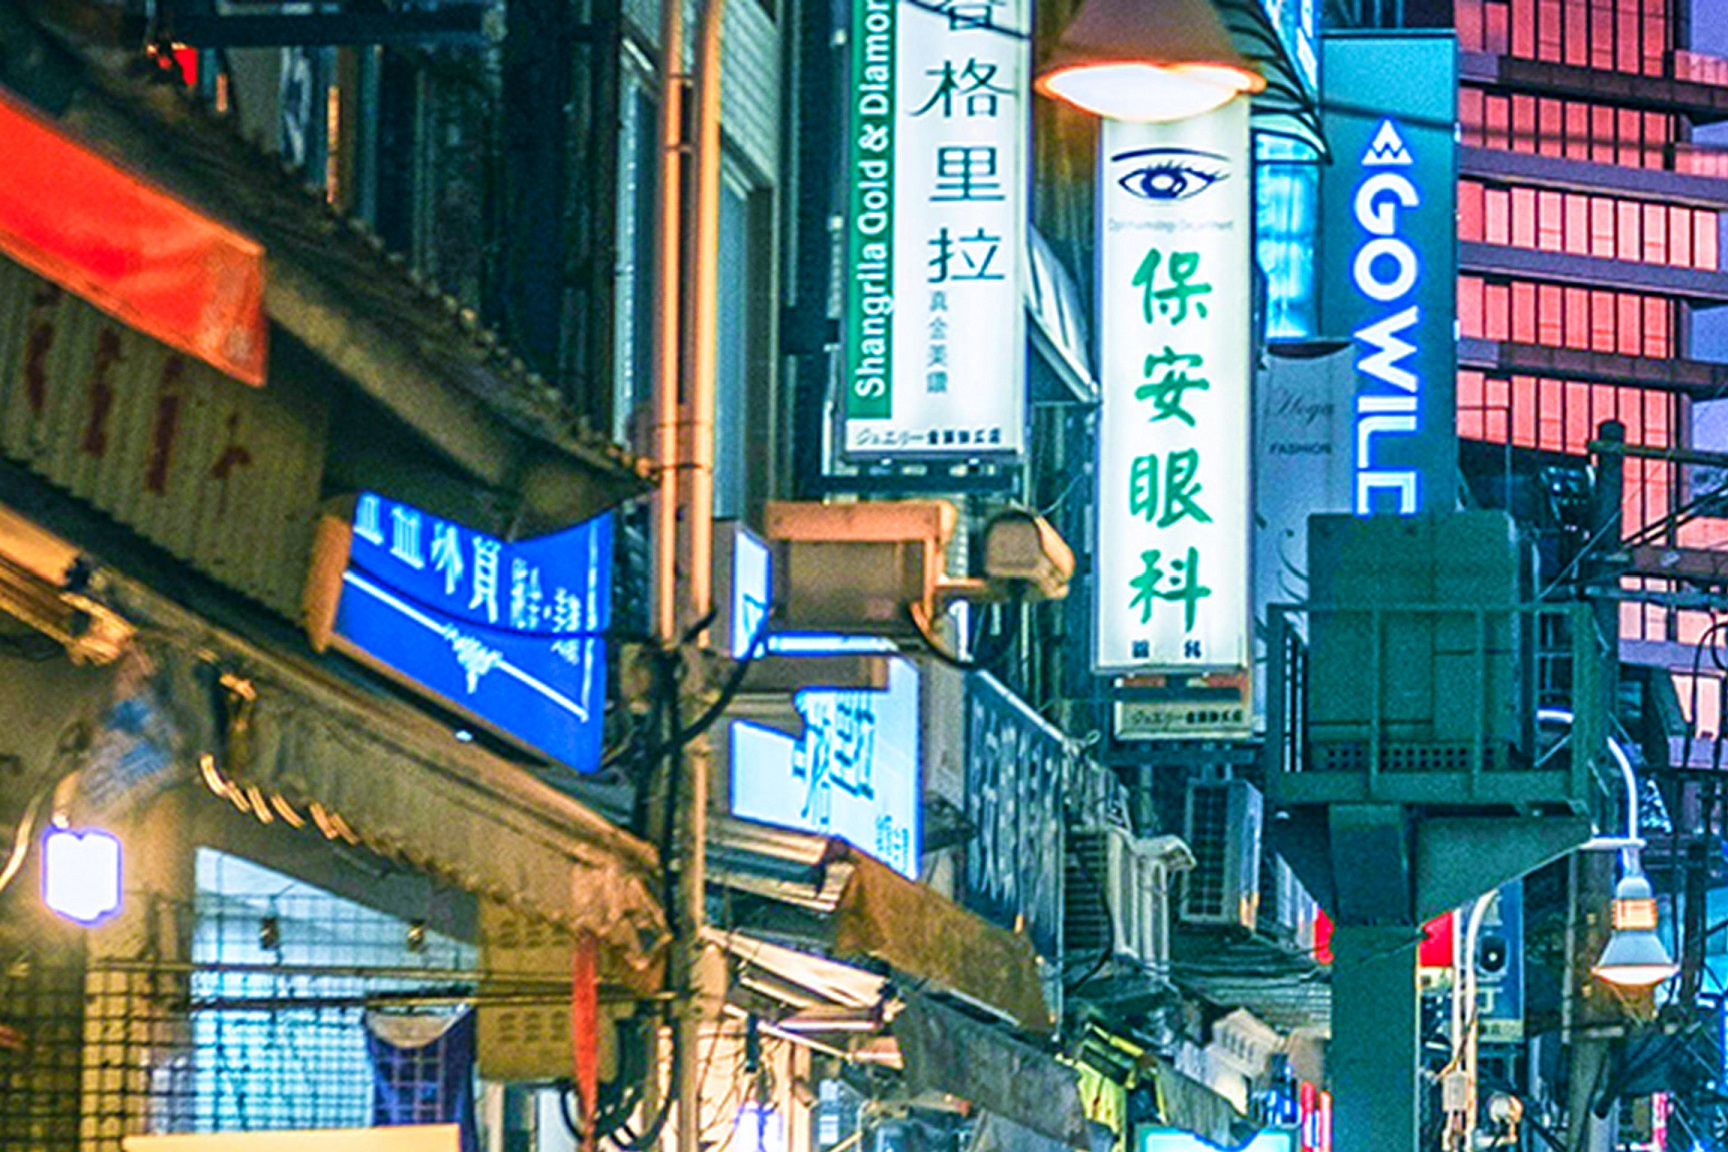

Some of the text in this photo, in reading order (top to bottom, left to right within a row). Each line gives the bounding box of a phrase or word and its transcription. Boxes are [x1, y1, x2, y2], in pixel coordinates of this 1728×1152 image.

[857, 124, 889, 152] &
[854, 243, 894, 398] Shangrila
[1126, 246, 1215, 633] 保安眼科
